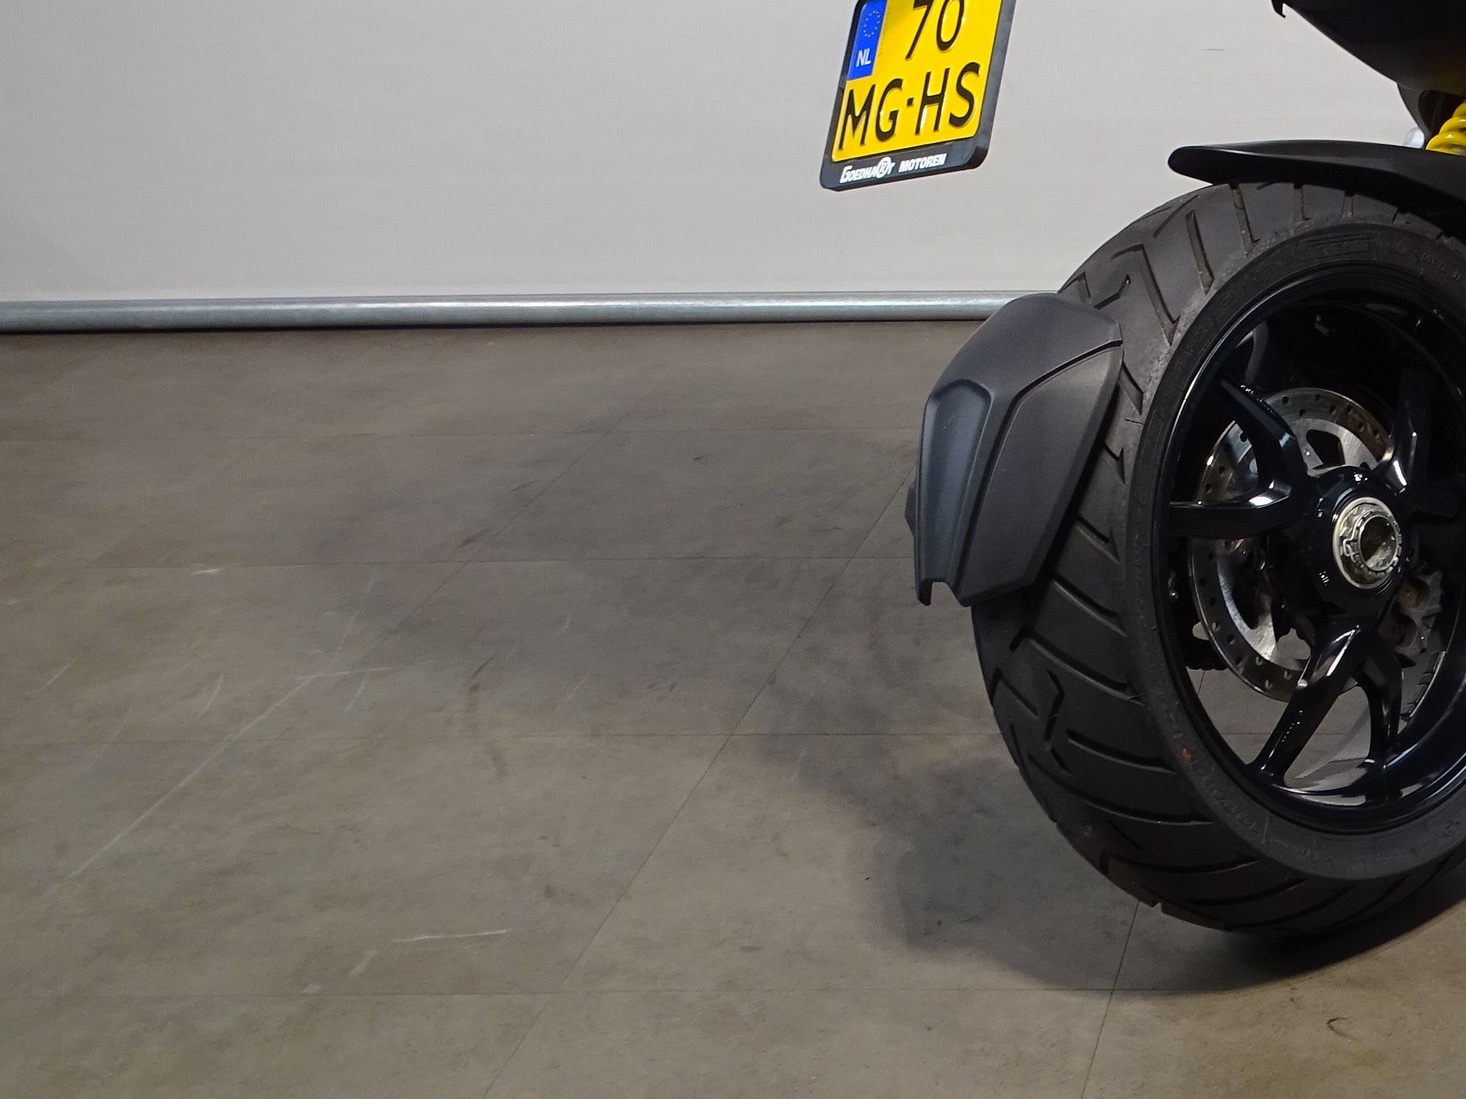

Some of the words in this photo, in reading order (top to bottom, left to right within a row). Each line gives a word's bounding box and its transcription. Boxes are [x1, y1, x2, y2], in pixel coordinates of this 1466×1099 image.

[856, 48, 872, 68] NL
[838, 62, 981, 151] MG-HS
[899, 153, 947, 173] MOTOREN
